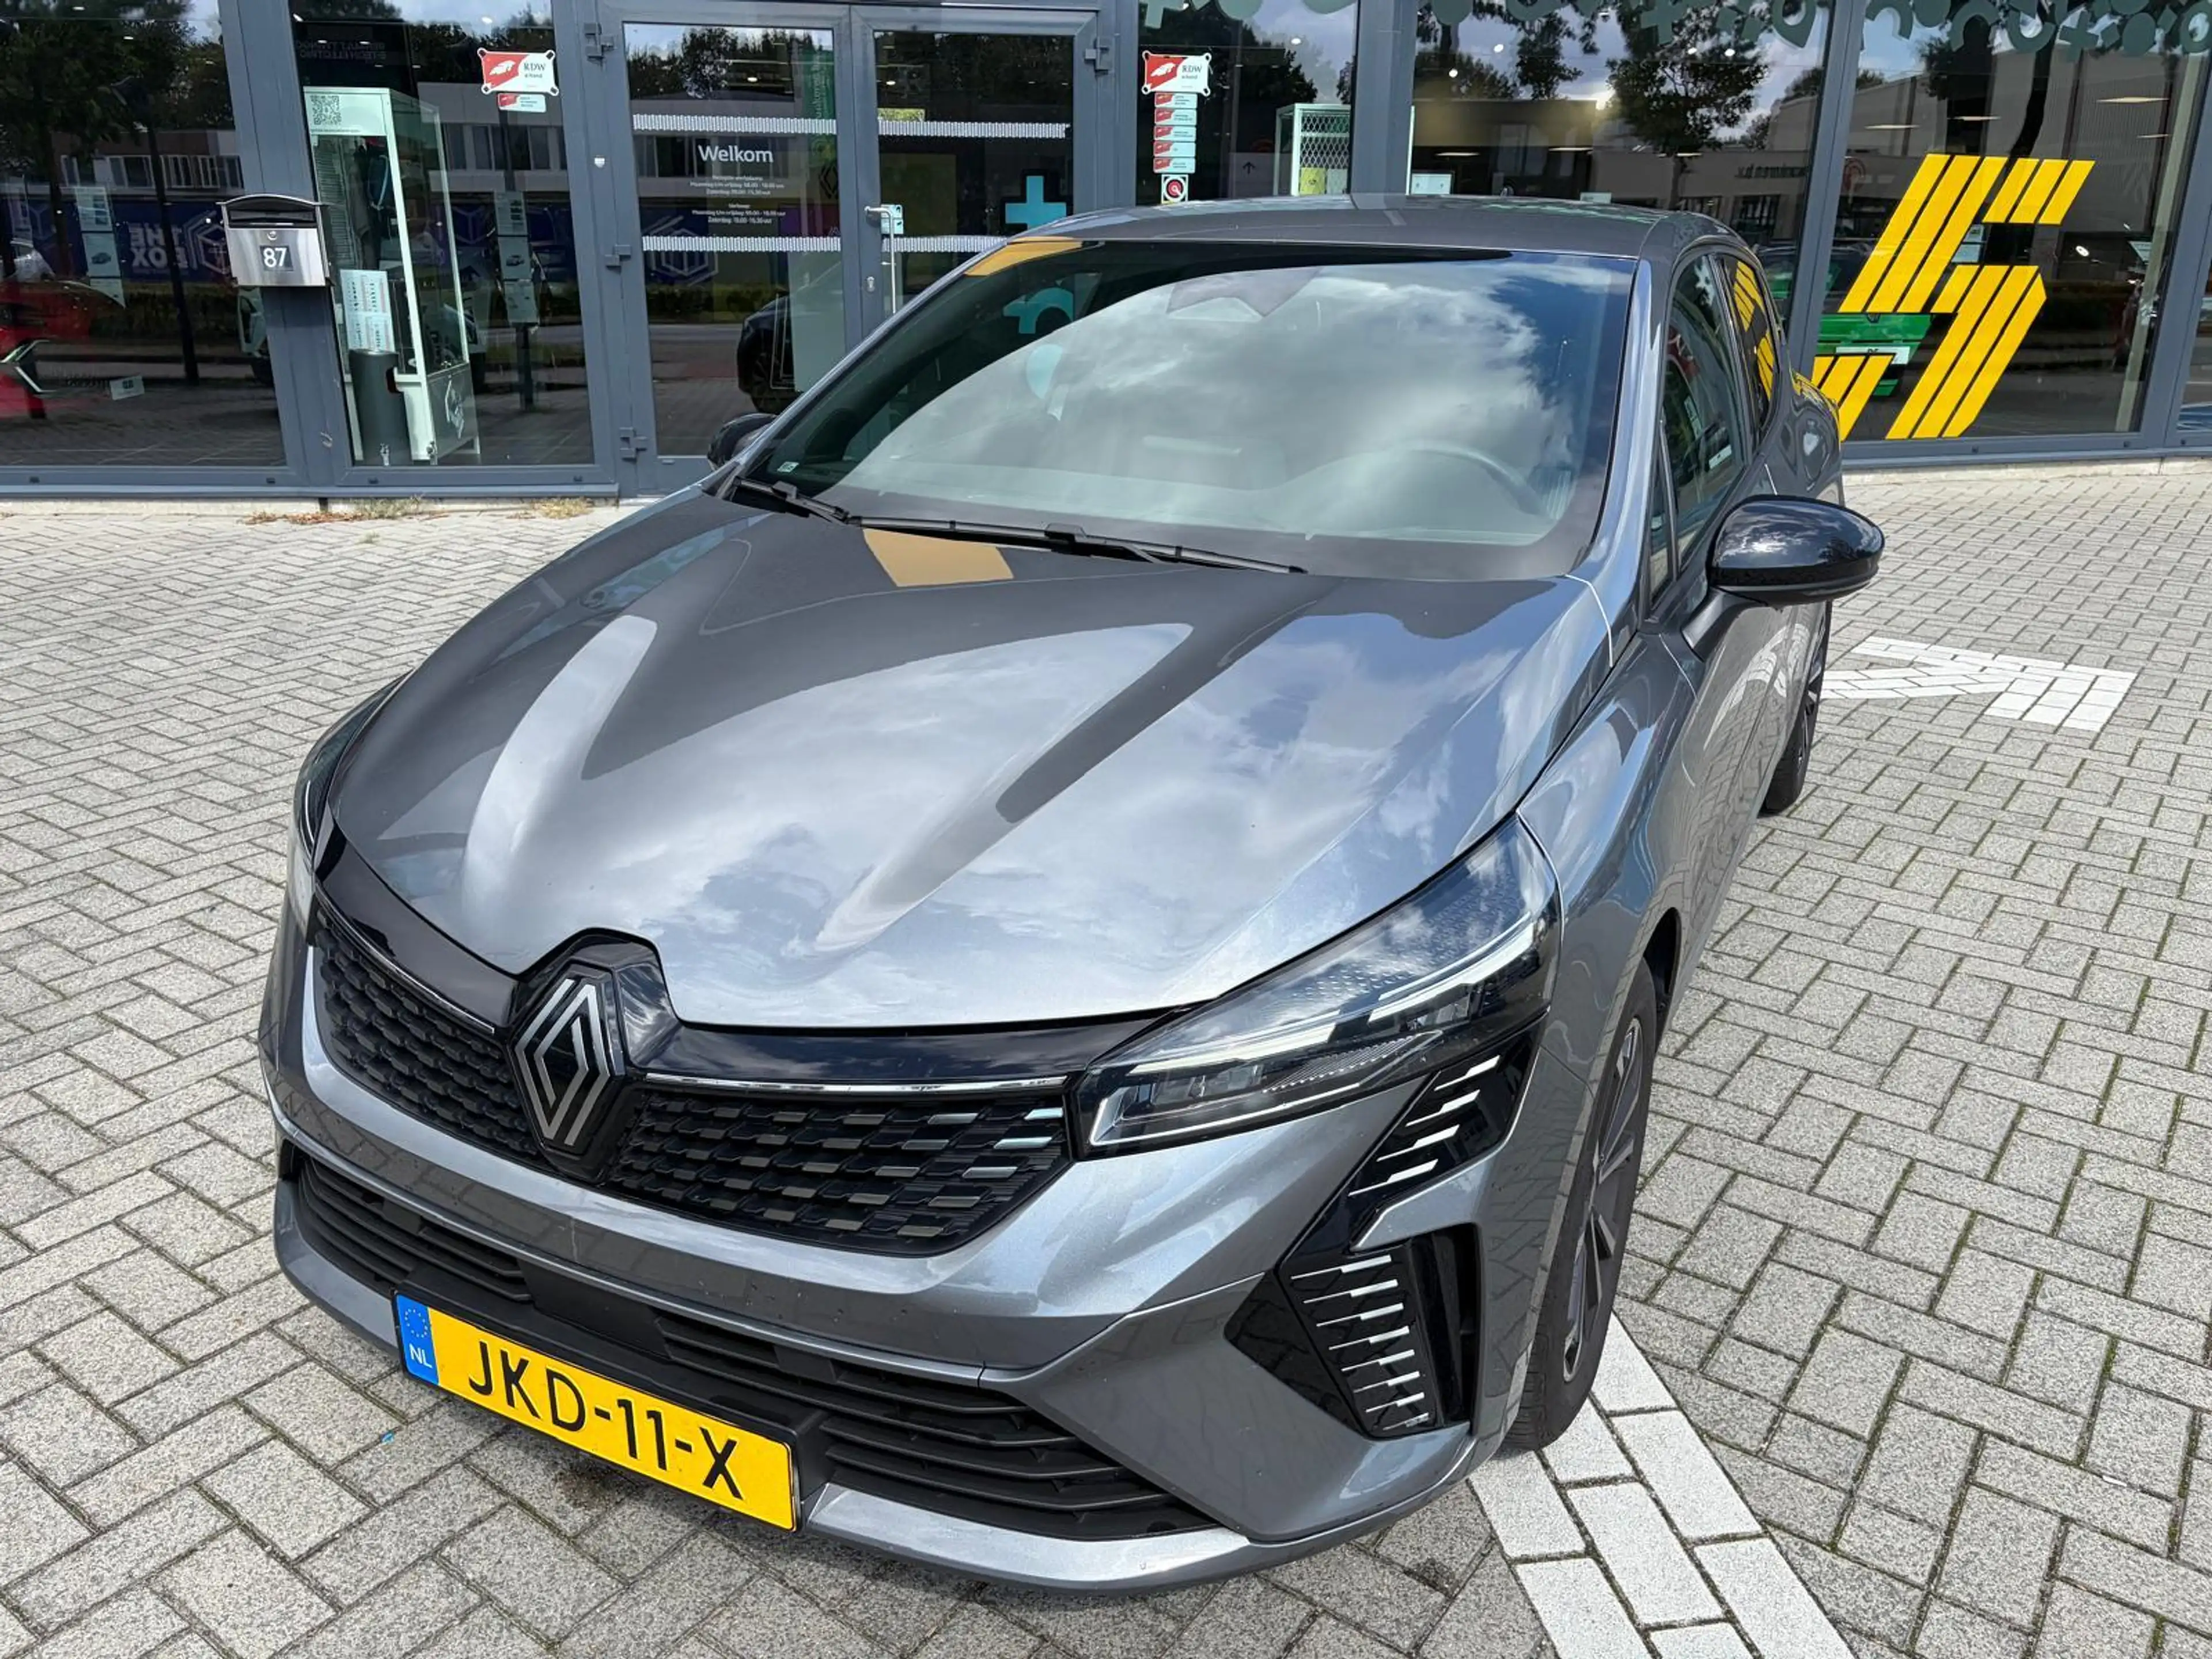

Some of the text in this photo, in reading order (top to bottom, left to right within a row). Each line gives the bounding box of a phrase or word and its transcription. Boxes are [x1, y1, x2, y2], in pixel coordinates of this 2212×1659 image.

[524, 62, 547, 71] RDW
[1181, 64, 1203, 73] RDW
[697, 145, 774, 163] Welkom
[263, 247, 287, 268] 87
[408, 1343, 433, 1369] NL
[468, 1341, 744, 1501] JKD-11-X
